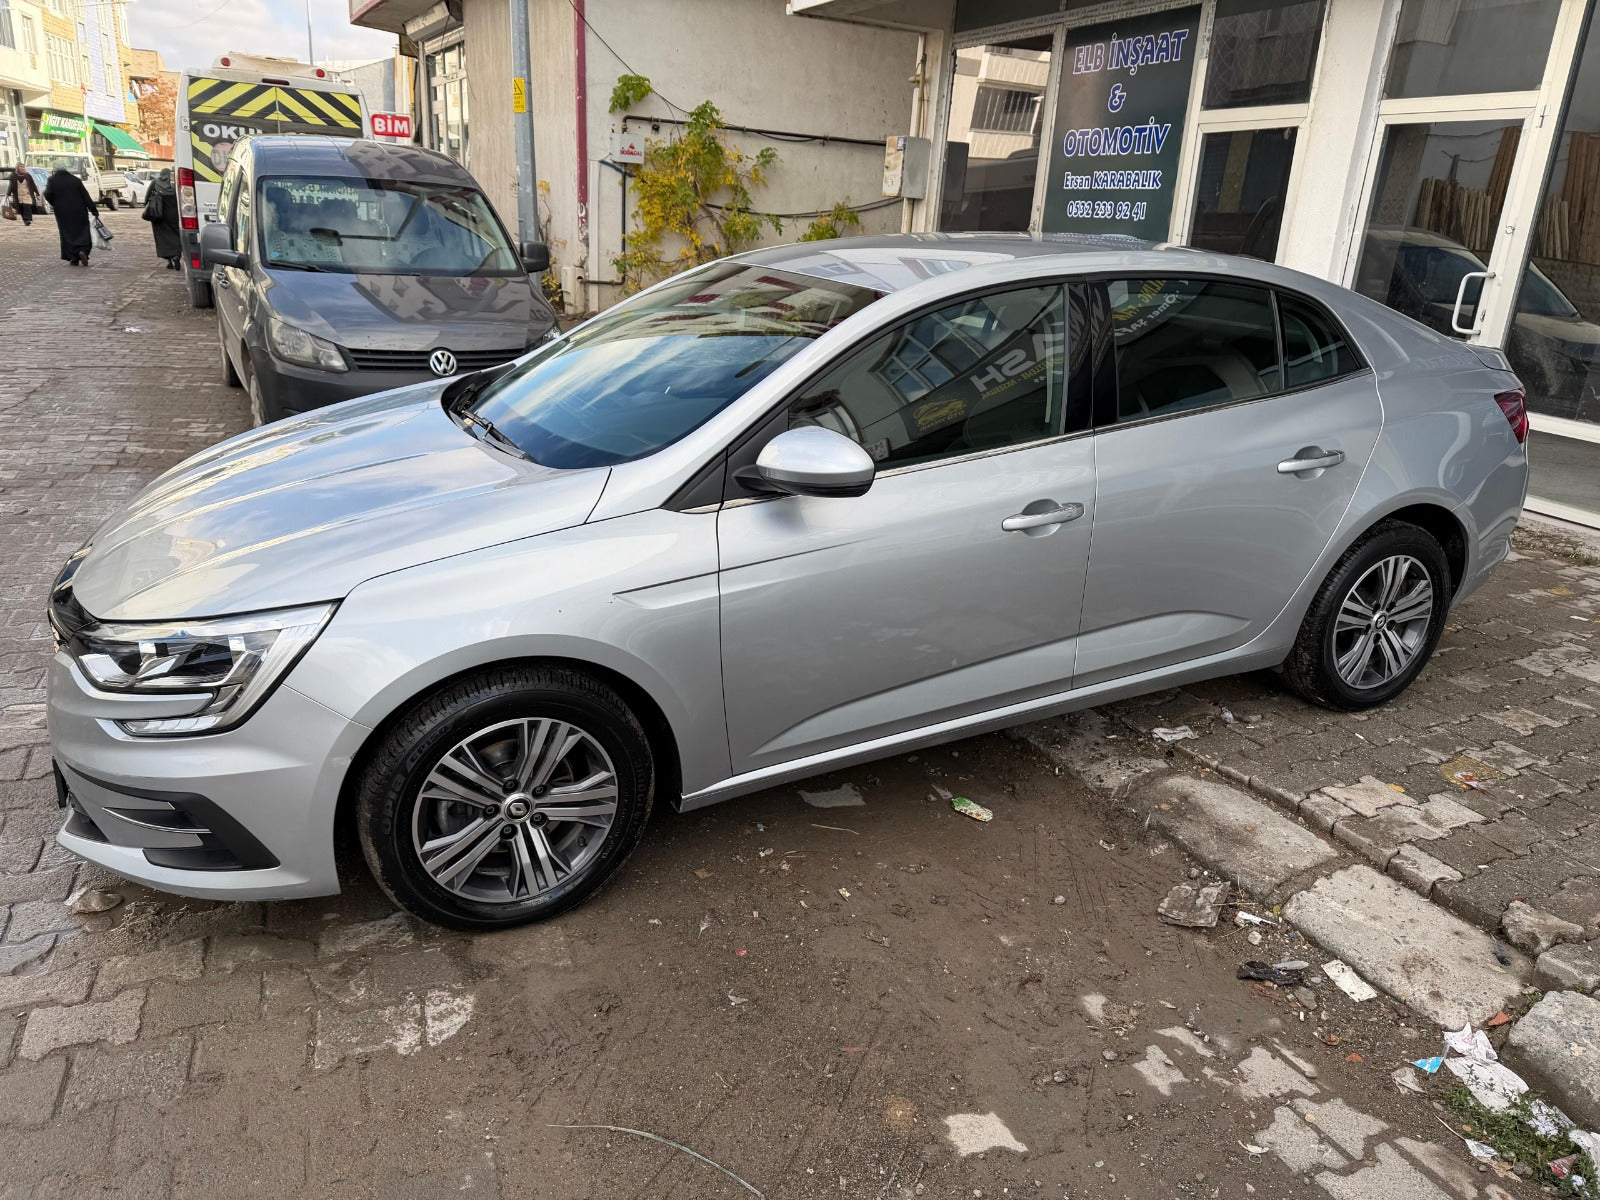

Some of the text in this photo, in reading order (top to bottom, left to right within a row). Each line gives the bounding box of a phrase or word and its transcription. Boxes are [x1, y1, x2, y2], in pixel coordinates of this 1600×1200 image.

[1073, 43, 1105, 75] ELB
[1107, 29, 1189, 75] İNŞAAT
[1108, 83, 1126, 113] &
[374, 115, 409, 134] BİM
[1063, 116, 1172, 157] OTOMOTİV
[1063, 170, 1162, 189] Ersan KARABALIK
[1067, 200, 1147, 221] 0532 233 92 41
